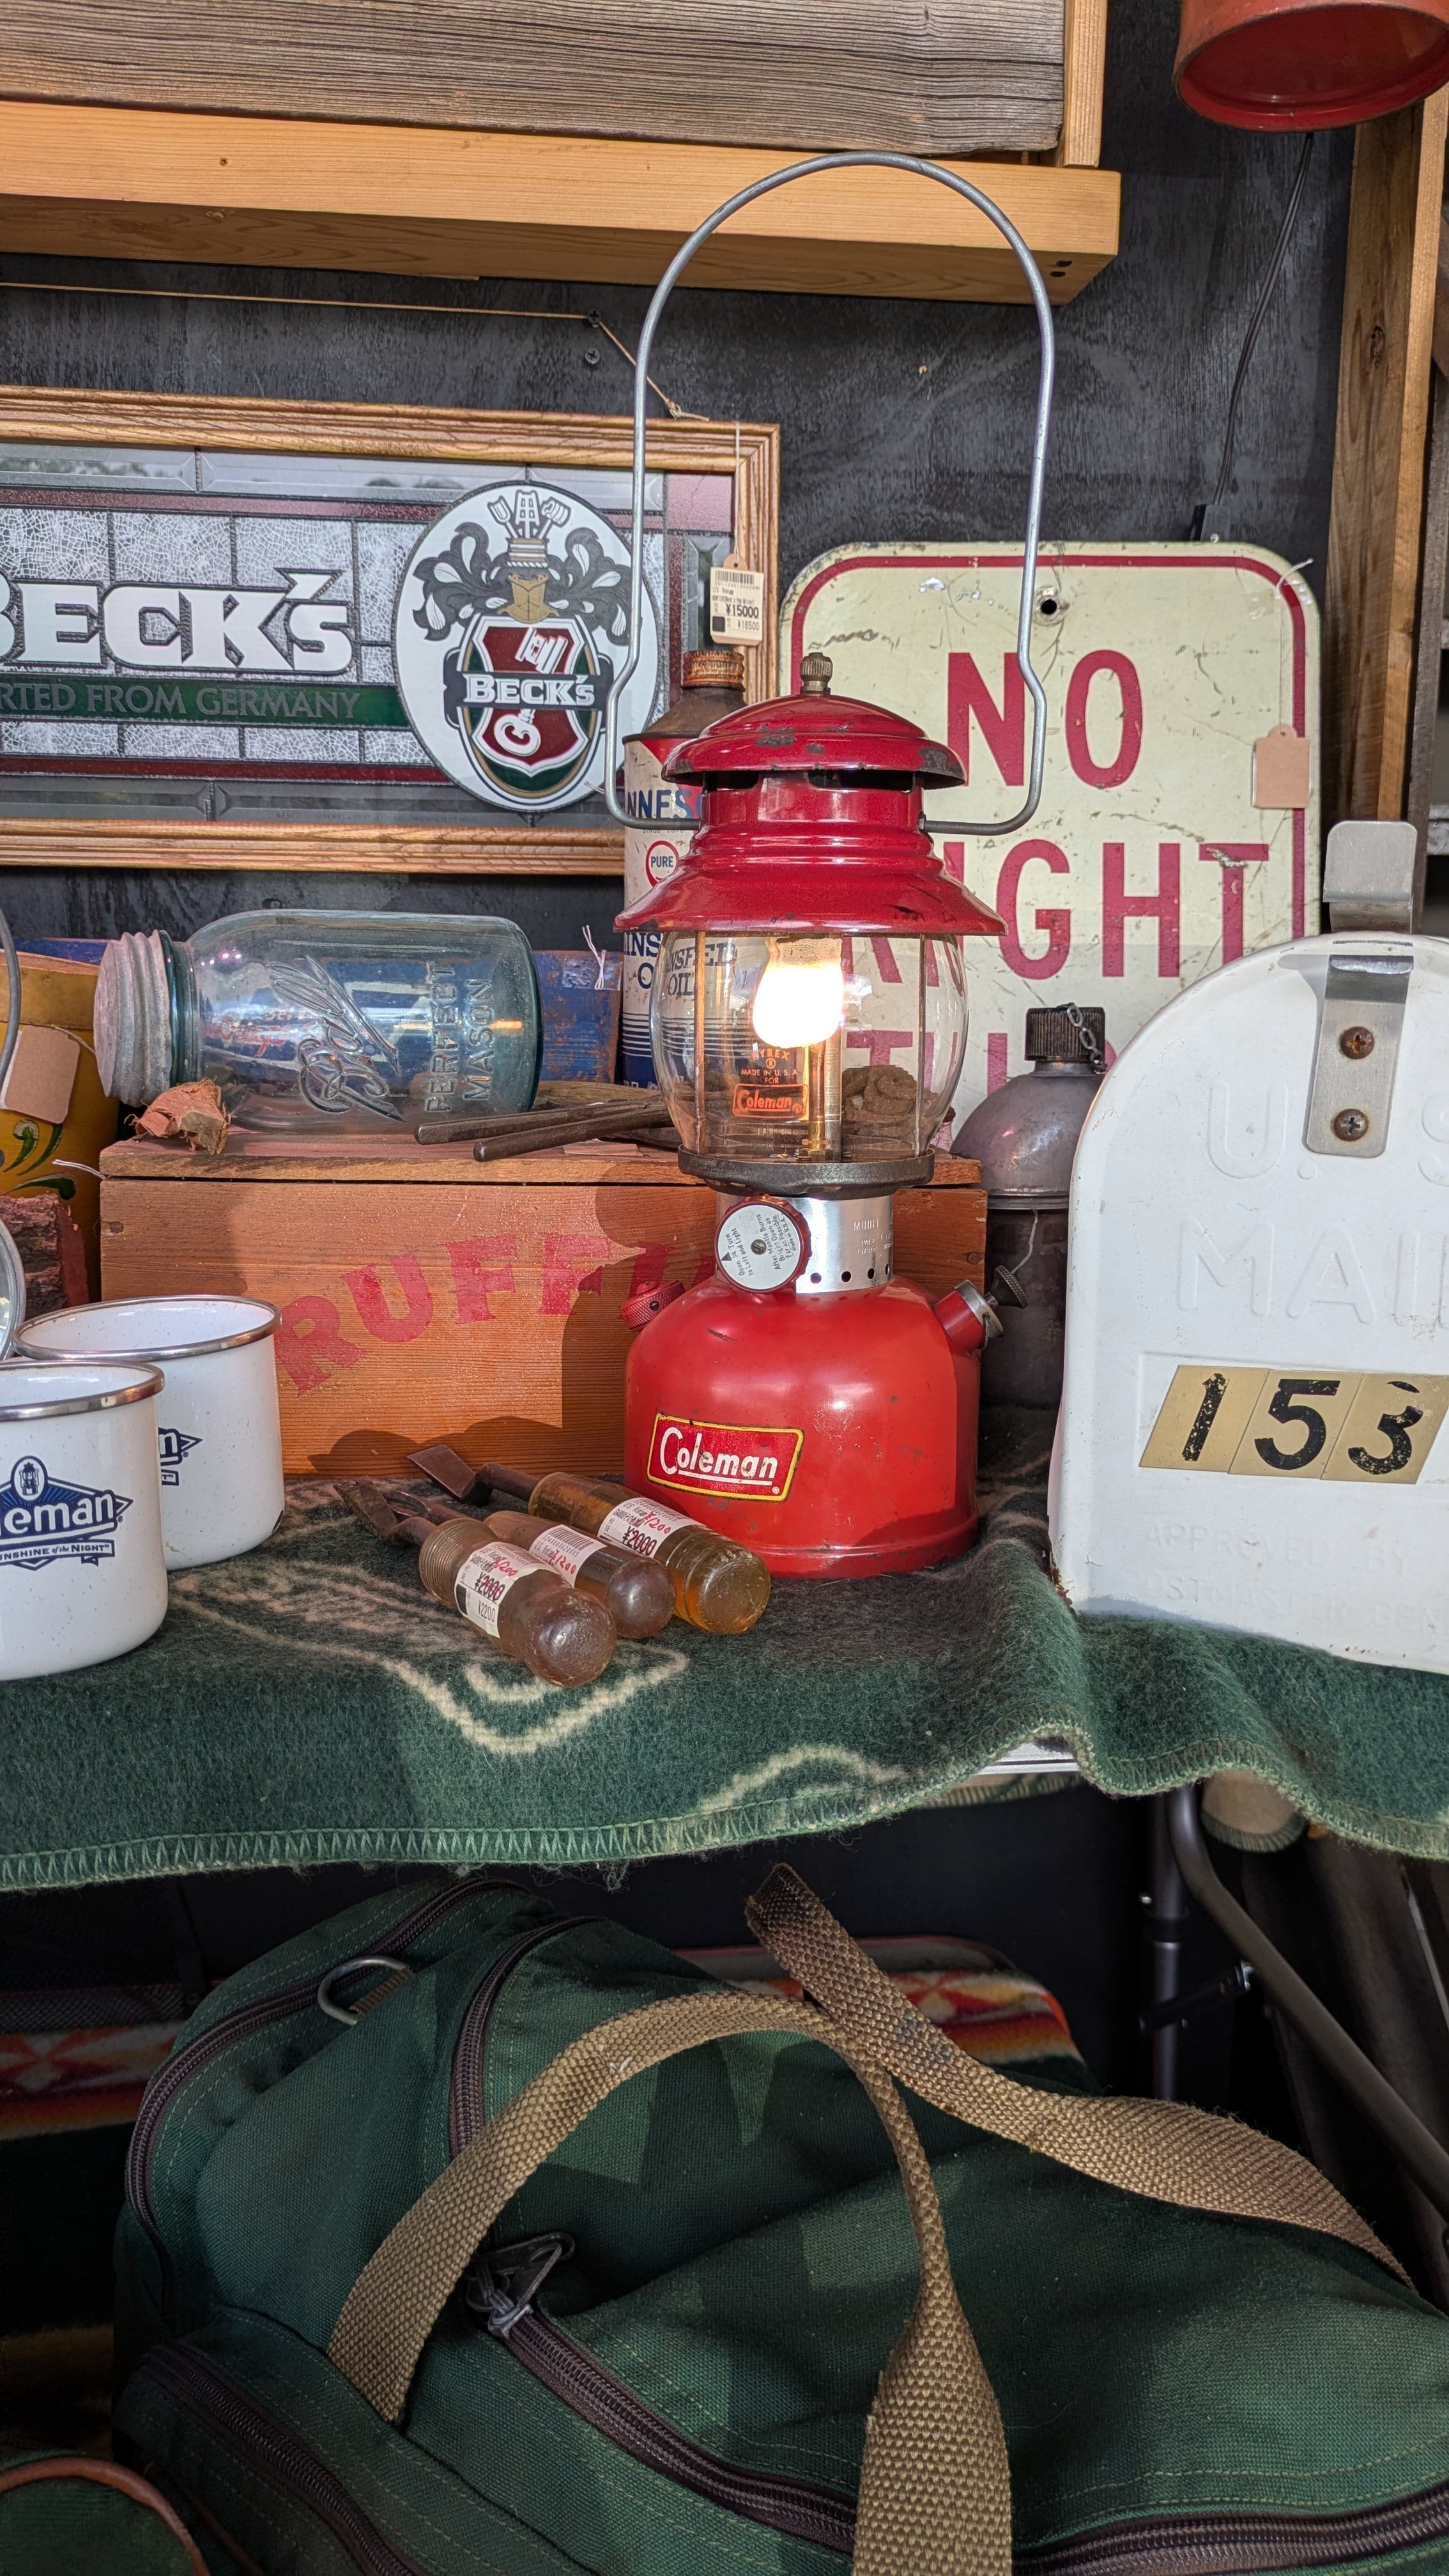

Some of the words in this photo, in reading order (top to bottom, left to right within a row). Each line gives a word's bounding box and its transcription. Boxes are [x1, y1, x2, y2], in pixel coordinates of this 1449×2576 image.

[0, 567, 355, 673] ECK'S
[726, 603, 759, 619] ¥15000
[86, 684, 187, 714] FROM
[196, 687, 360, 719] GERMANY
[947, 649, 1143, 789] NO
[650, 855, 674, 868] PURE
[424, 960, 458, 1113] PERFECT
[463, 977, 496, 1101] MASON
[751, 1048, 790, 1061] PYREX
[741, 1068, 761, 1077] MADE
[737, 1089, 792, 1112] Coleman
[756, 1213, 767, 1233] Burns
[769, 1225, 778, 1241] Open
[772, 1215, 785, 1241] Possible
[726, 1234, 735, 1249] Turn
[730, 1227, 741, 1245] Light
[763, 1232, 773, 1255] Mantle
[737, 1243, 746, 1255] and
[737, 1261, 746, 1276] Open
[1176, 1217, 1449, 1330] MAI
[1181, 1373, 1424, 1476] 153
[659, 1426, 778, 1479] Coleman
[622, 1526, 657, 1556] ¥2000
[474, 1571, 506, 1601] ¥2000
[478, 1600, 496, 1623] ¥2200
